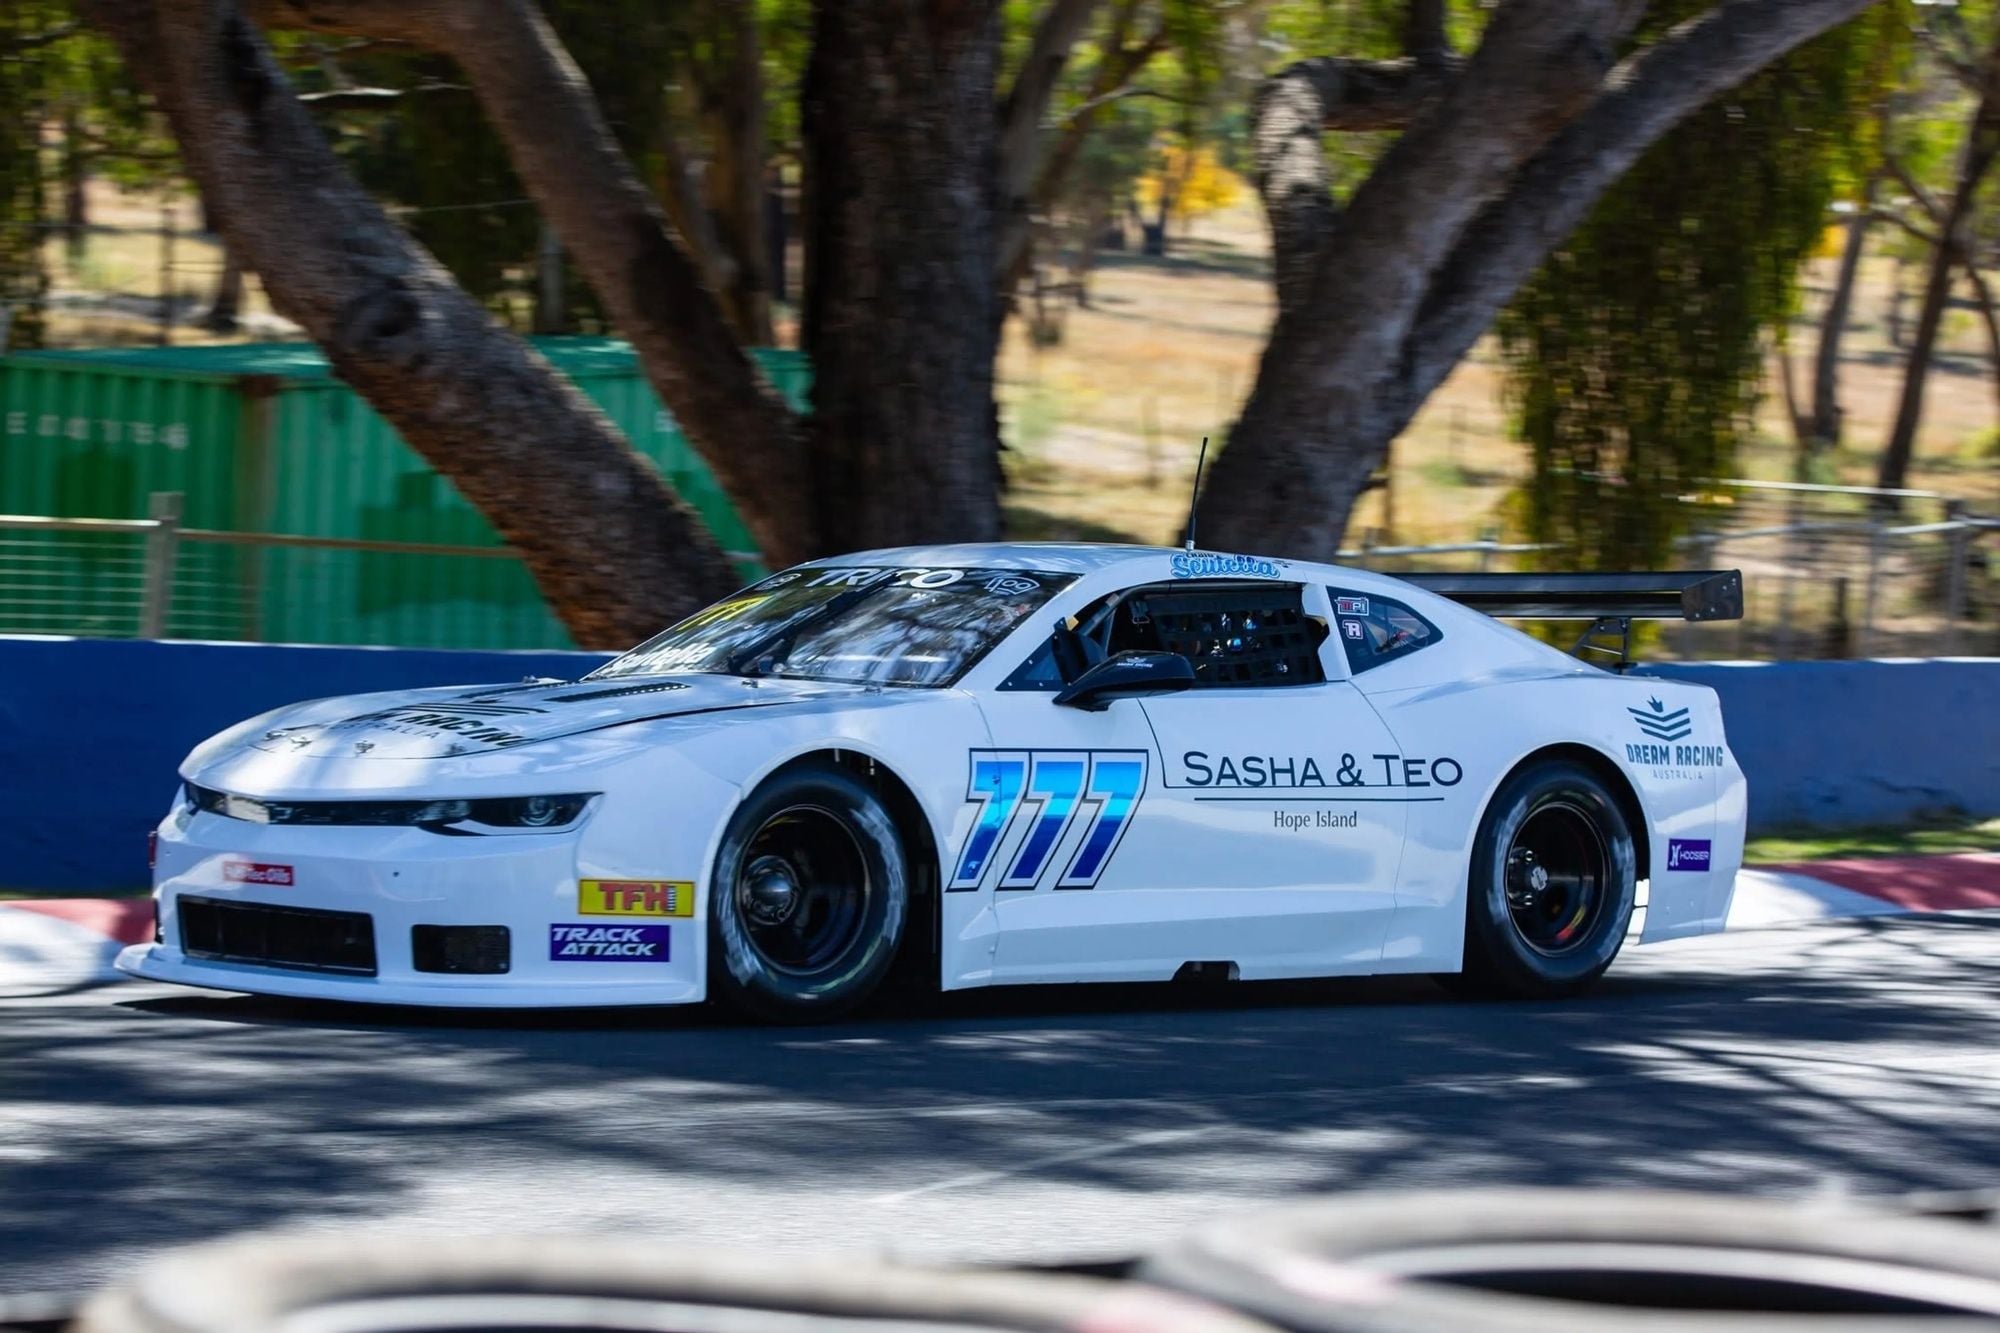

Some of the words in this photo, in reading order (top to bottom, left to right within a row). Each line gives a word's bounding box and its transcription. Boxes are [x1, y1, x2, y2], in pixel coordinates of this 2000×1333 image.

[1625, 743, 1670, 765] DREAM
[1676, 746, 1723, 767] RACING
[1183, 751, 1326, 787] SASHA
[1336, 753, 1365, 787] &
[1373, 754, 1463, 787] TEO
[1652, 770, 1704, 780] AUSTRALIA
[1273, 811, 1311, 832] Hope
[1316, 811, 1357, 828] Island
[598, 882, 669, 912] TFH
[552, 927, 646, 942] TRACK
[558, 942, 657, 957] ATTACK
